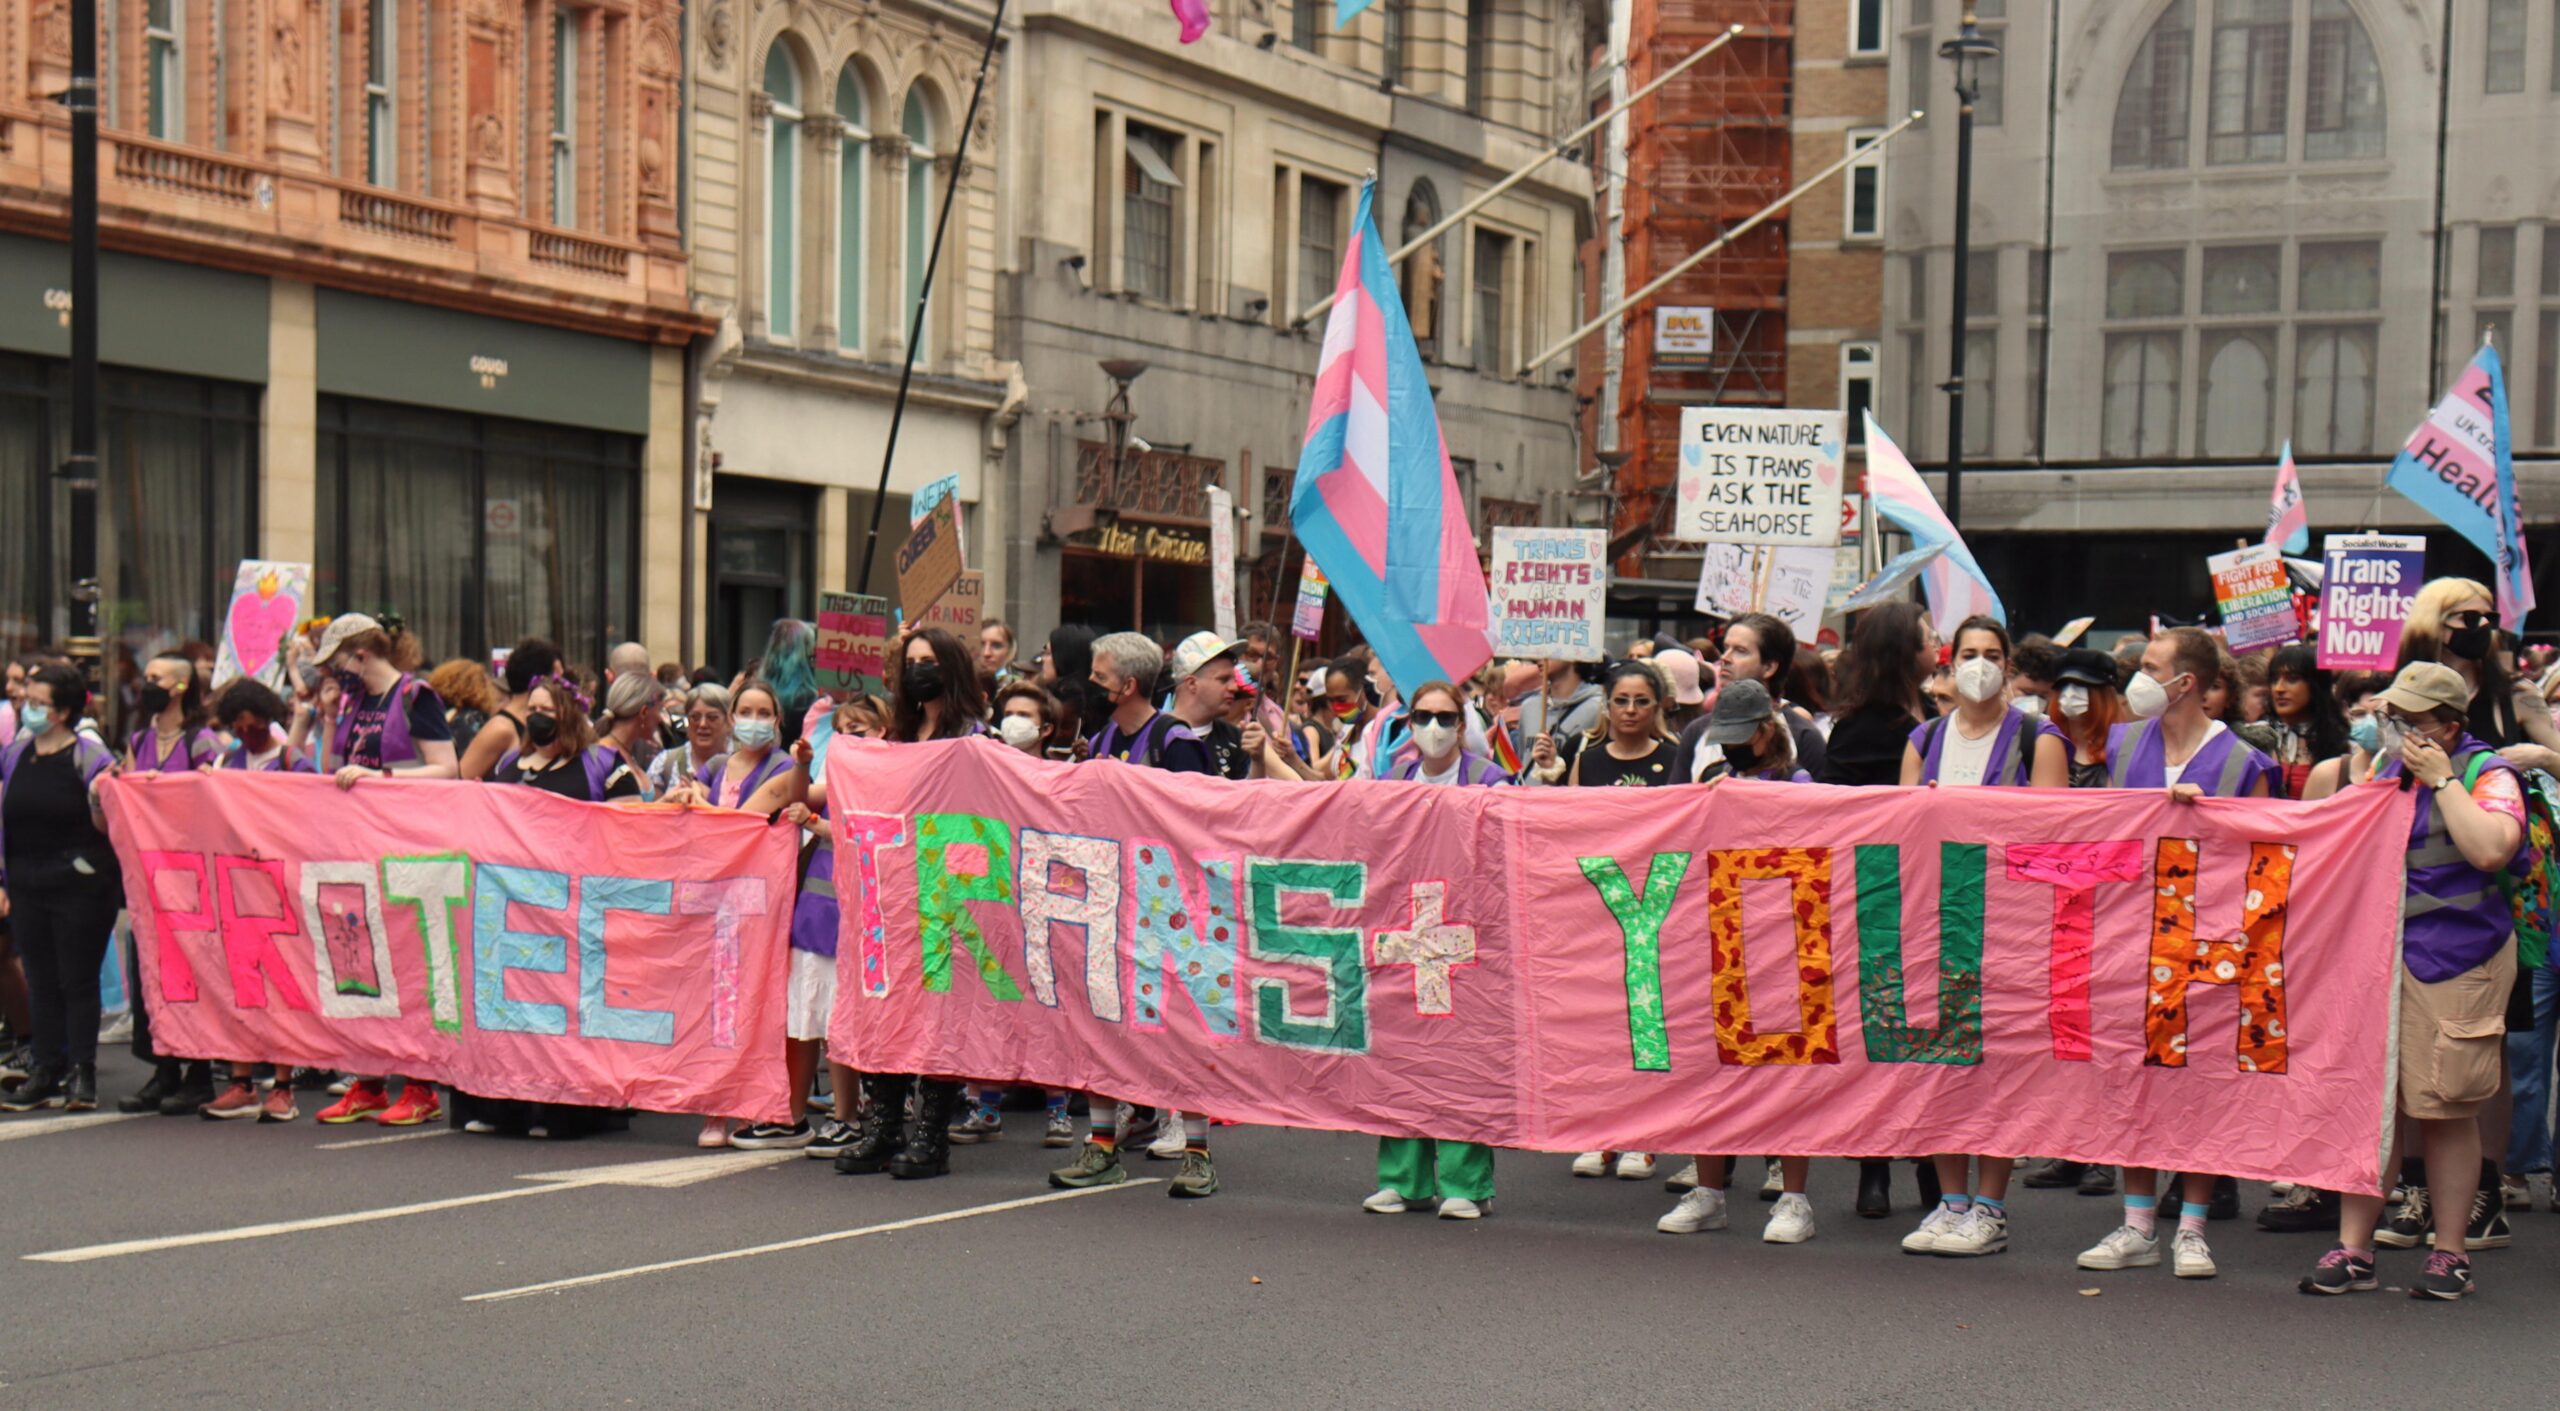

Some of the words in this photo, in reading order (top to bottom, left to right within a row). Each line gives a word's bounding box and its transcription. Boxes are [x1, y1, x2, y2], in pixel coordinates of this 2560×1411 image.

[1702, 423, 1752, 443] EVEN
[1758, 424, 1824, 446] NATURE
[2454, 413, 2479, 438] UK
[1711, 454, 1737, 476] IS
[1746, 455, 1813, 479] TRANS
[1708, 482, 1754, 505] ASK
[1764, 483, 1812, 505] THE
[1699, 511, 1813, 536] SEAHORSE
[900, 518, 937, 575] QUEER
[1513, 538, 1586, 561] TRANS
[2342, 539, 2377, 549] Socialist
[2379, 540, 2408, 549] Worker
[1505, 561, 1592, 586] RIGHTS
[2217, 567, 2253, 586] FIGHT
[2255, 560, 2280, 577] FOR
[2328, 550, 2402, 585] Trans
[1529, 582, 1566, 600] ARE
[2229, 575, 2275, 597] TRANS
[823, 593, 856, 612] THEY
[1507, 599, 1585, 620] HUMAN
[2222, 588, 2289, 614] LIBERATION
[2225, 612, 2245, 624] AND
[2246, 601, 2292, 619] SOCIALISM
[2328, 585, 2416, 628] Rights
[837, 614, 872, 635] NOT
[1501, 618, 1590, 647] RIGHTS
[2326, 621, 2385, 656] Now
[827, 639, 881, 668] ERASE
[837, 666, 863, 690] US
[140, 849, 768, 1048] PROTECT
[1576, 836, 2299, 1074] YOUTH
